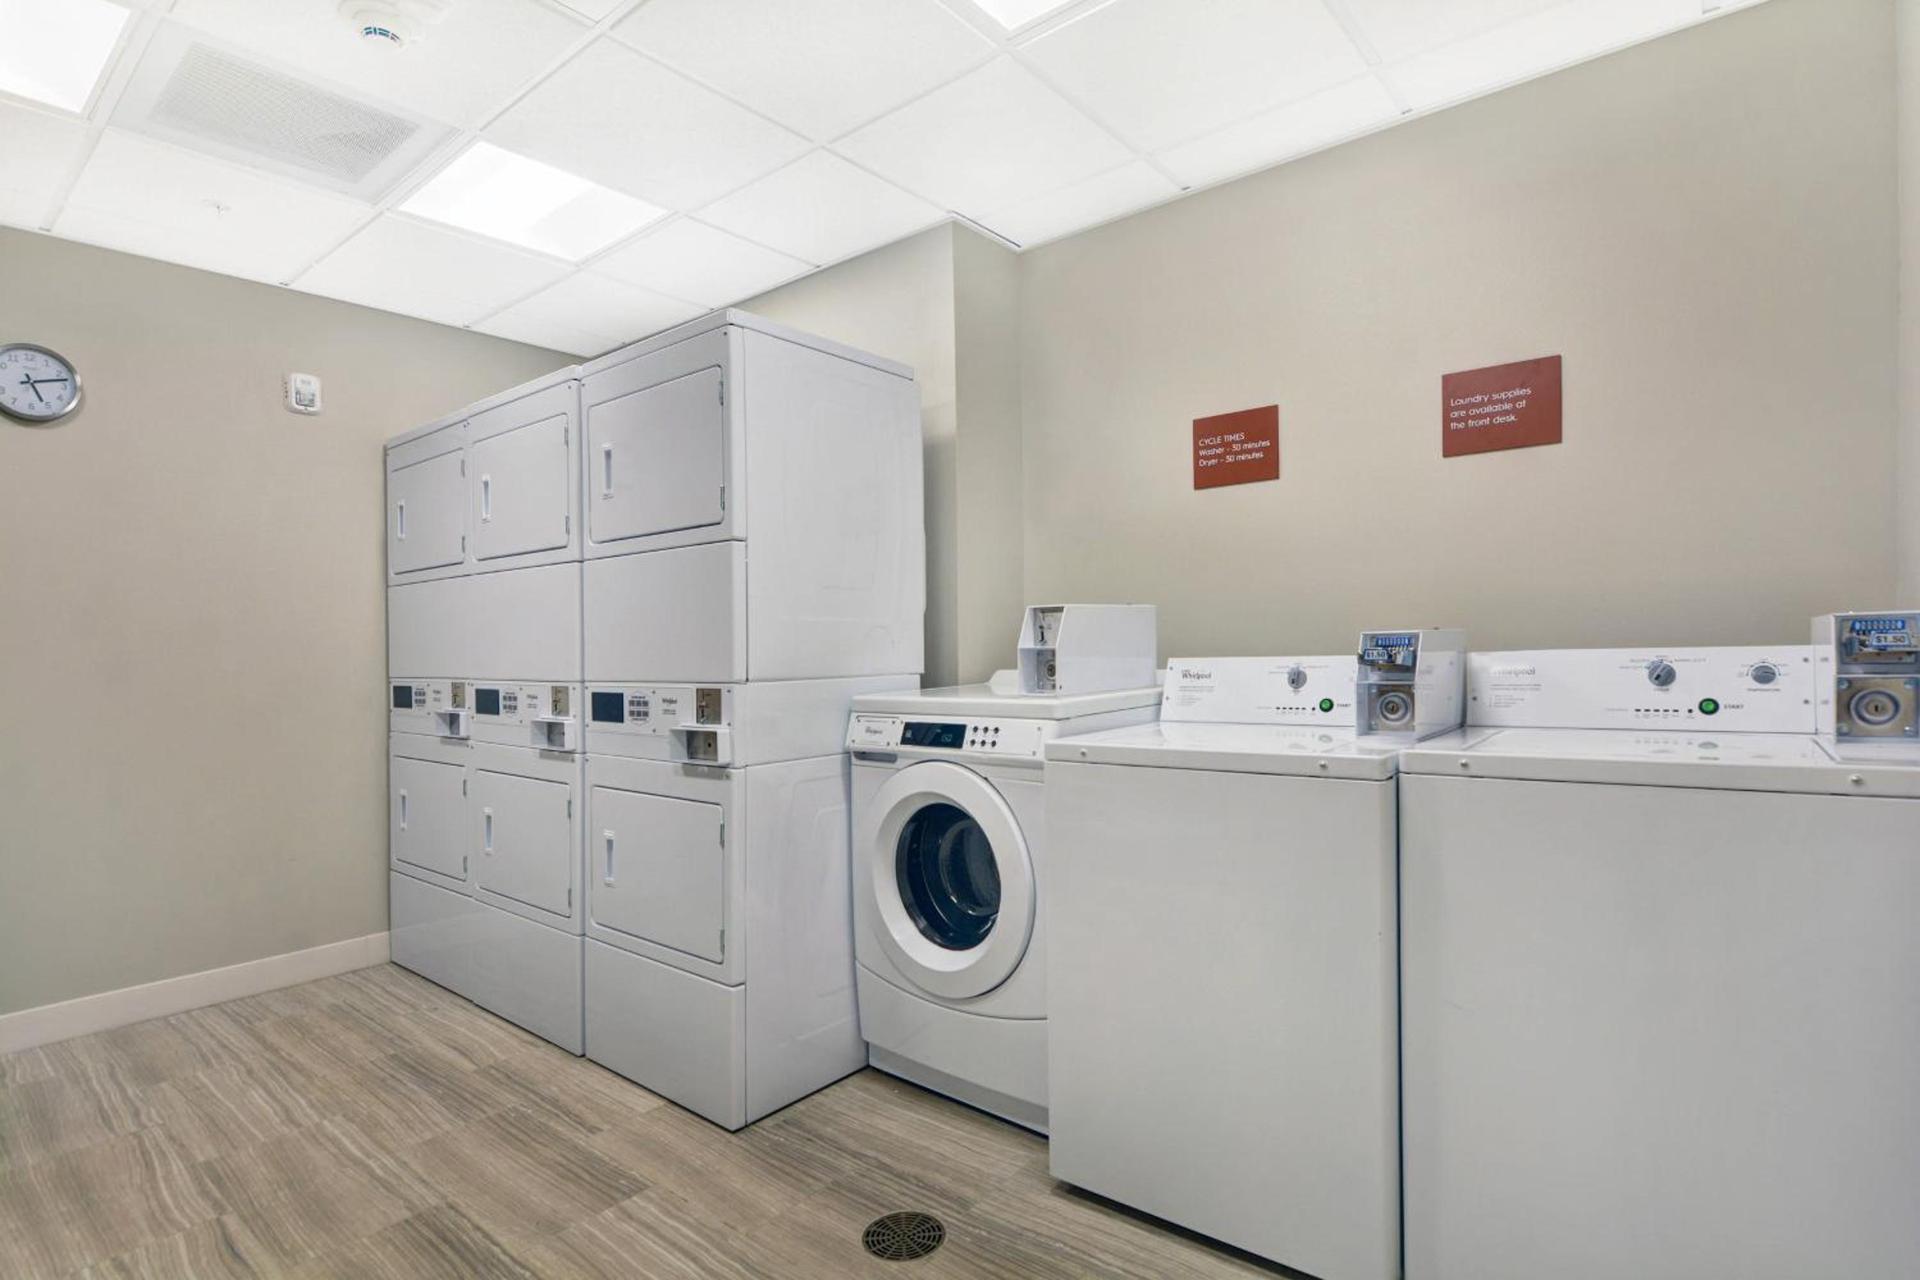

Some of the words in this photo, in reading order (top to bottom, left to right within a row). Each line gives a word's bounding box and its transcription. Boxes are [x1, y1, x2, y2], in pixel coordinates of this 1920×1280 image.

[1450, 394, 1489, 407] Laundry
[1491, 388, 1532, 400] supplies
[1450, 410, 1466, 418] are
[1469, 403, 1513, 416] available
[1516, 400, 1526, 409] at
[1450, 421, 1465, 430] the
[1468, 417, 1490, 427] front
[1198, 436, 1222, 446] CYCLE
[1199, 447, 1224, 457] Washer
[1243, 440, 1270, 449] minutes
[1199, 458, 1218, 468] Dryer
[1236, 451, 1264, 461] minutes
